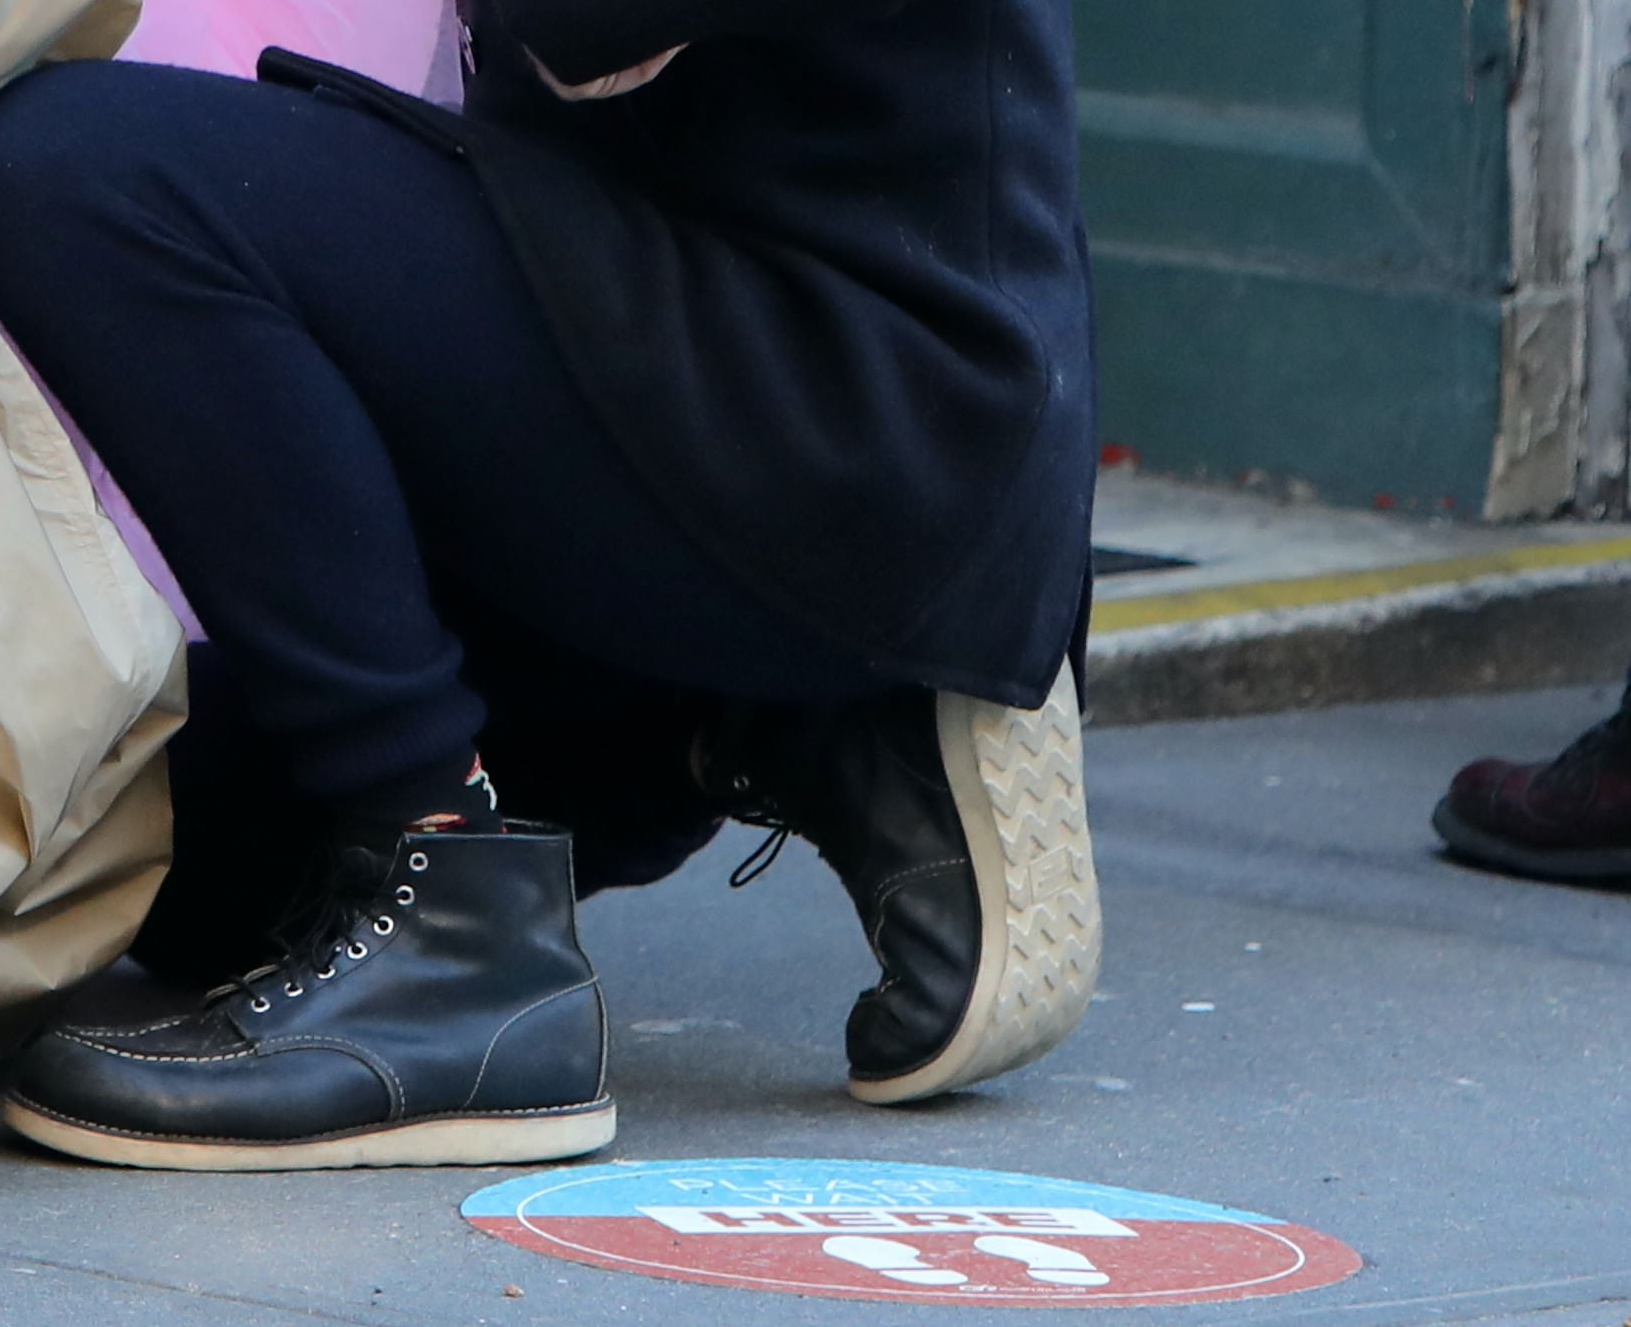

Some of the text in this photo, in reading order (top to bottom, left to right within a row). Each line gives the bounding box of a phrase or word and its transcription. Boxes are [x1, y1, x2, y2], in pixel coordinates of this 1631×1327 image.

[669, 1178, 968, 1192] PLEASE
[740, 1192, 935, 1205] WAIT
[699, 1211, 1077, 1229] HERE
